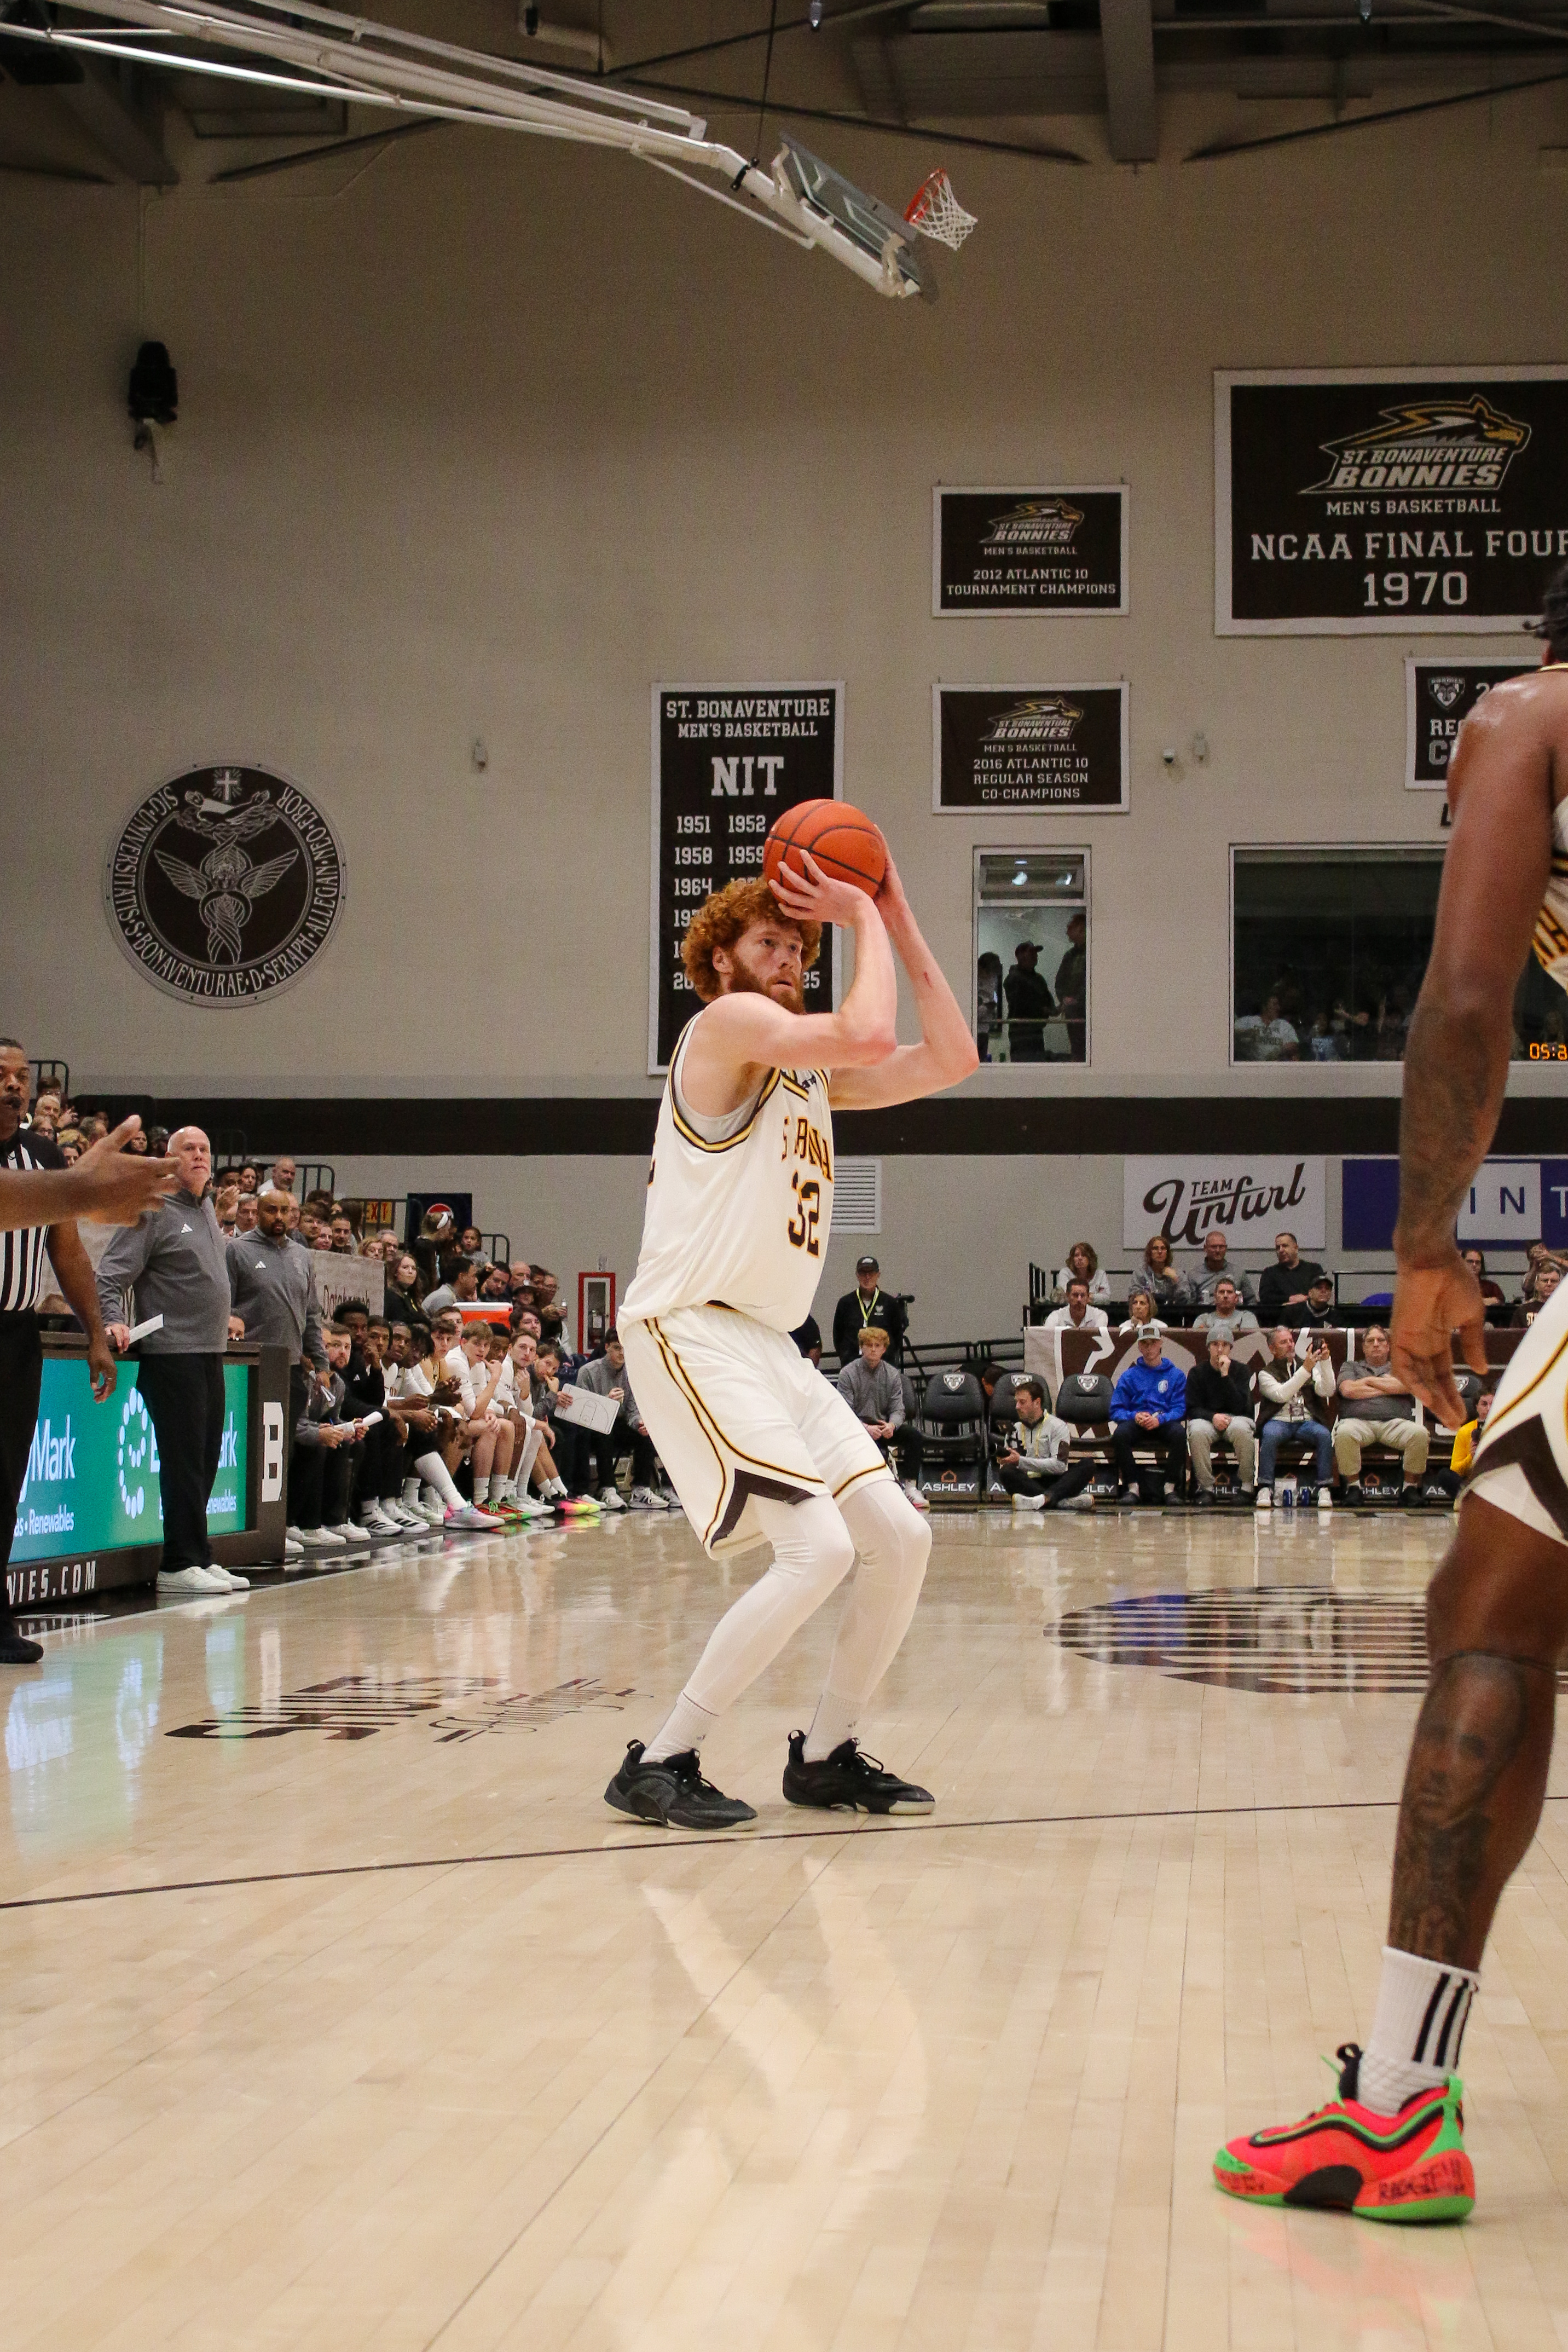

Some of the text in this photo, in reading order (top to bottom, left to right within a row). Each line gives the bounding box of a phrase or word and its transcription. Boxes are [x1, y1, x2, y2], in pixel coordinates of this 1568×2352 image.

[1341, 447, 1507, 465] ST. BONAVENTURE
[1330, 465, 1502, 488] BONNIES
[1326, 499, 1501, 516] MEN'S BASKETBALL
[994, 530, 1071, 541] BONNIES
[984, 546, 1078, 556] MEN'S BASKETBALL
[1251, 533, 1353, 560] NCAA
[1365, 531, 1473, 559] FINAL
[973, 569, 1088, 580] 2012 ATLANTIC 10
[946, 583, 1116, 595] TOURNAMENT CHAMPIONS
[1363, 571, 1468, 606] 1970
[666, 698, 830, 718] ST. BONAVENTURE
[678, 722, 818, 738] MEN'S BASKETBALL
[994, 727, 1071, 738] BONNIES
[1016, 743, 1077, 752] BASKETBALL
[973, 758, 1088, 770] 2016 ATLANTIC 10
[711, 756, 784, 796] NIT
[974, 773, 1089, 784] REGULAR SEASON
[982, 788, 1080, 799] CO-CHAMPIONS
[676, 815, 766, 834] 1951 1952
[674, 846, 765, 865] 1958 1959
[674, 877, 713, 896] 1964
[1191, 1178, 1233, 1197] TEAM
[1143, 1163, 1306, 1245] Unfurl
[922, 1482, 975, 1492] ASHLEY
[29, 1504, 74, 1535] Renewables
